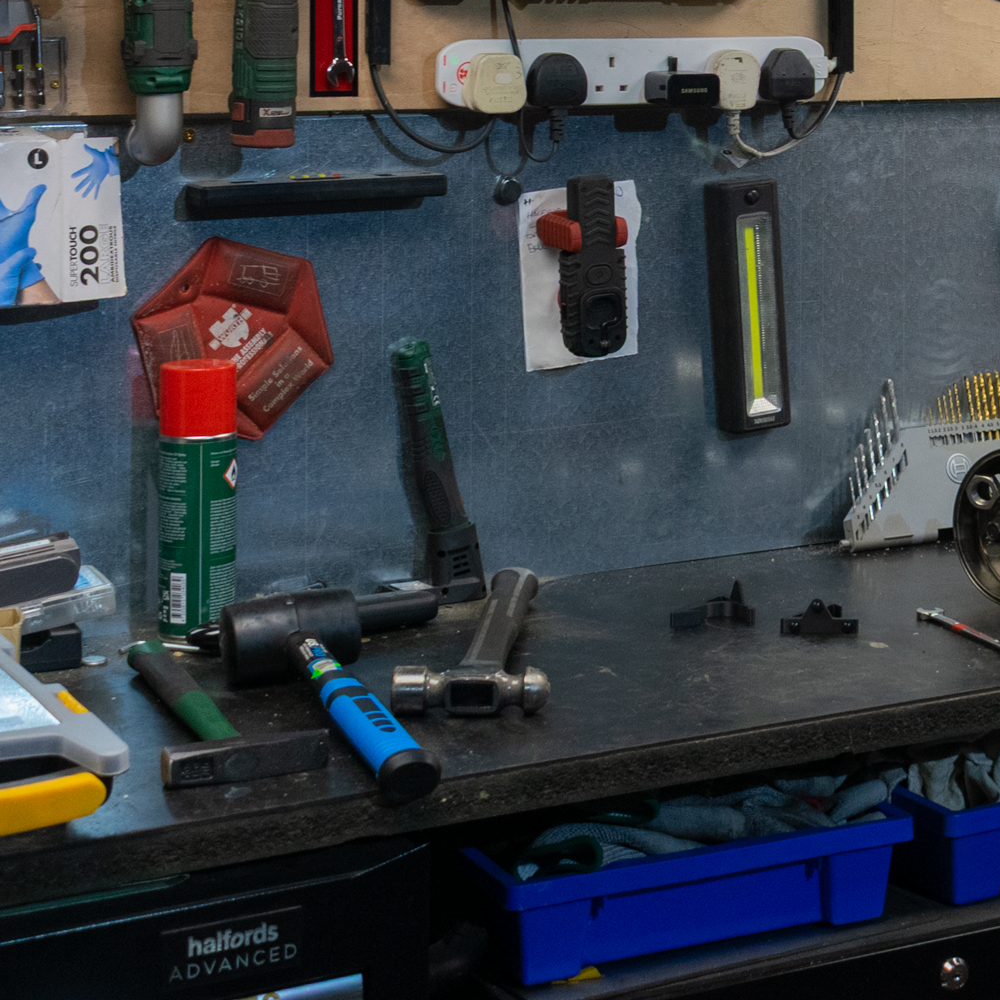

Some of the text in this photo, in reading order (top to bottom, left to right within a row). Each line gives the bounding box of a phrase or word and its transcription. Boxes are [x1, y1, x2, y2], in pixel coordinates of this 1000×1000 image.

[34, 153, 43, 165] L
[69, 226, 78, 287] SUPERTOUCH
[79, 224, 99, 286] 200
[99, 223, 110, 284] LARGE
[235, 331, 274, 370] ROFESSIONALS
[239, 327, 267, 356] ASSEMBLY
[247, 377, 273, 402] Simple
[262, 358, 314, 412] Complex World
[274, 379, 285, 388] in
[187, 921, 279, 958] halfords
[168, 943, 298, 983] ADVANCED
